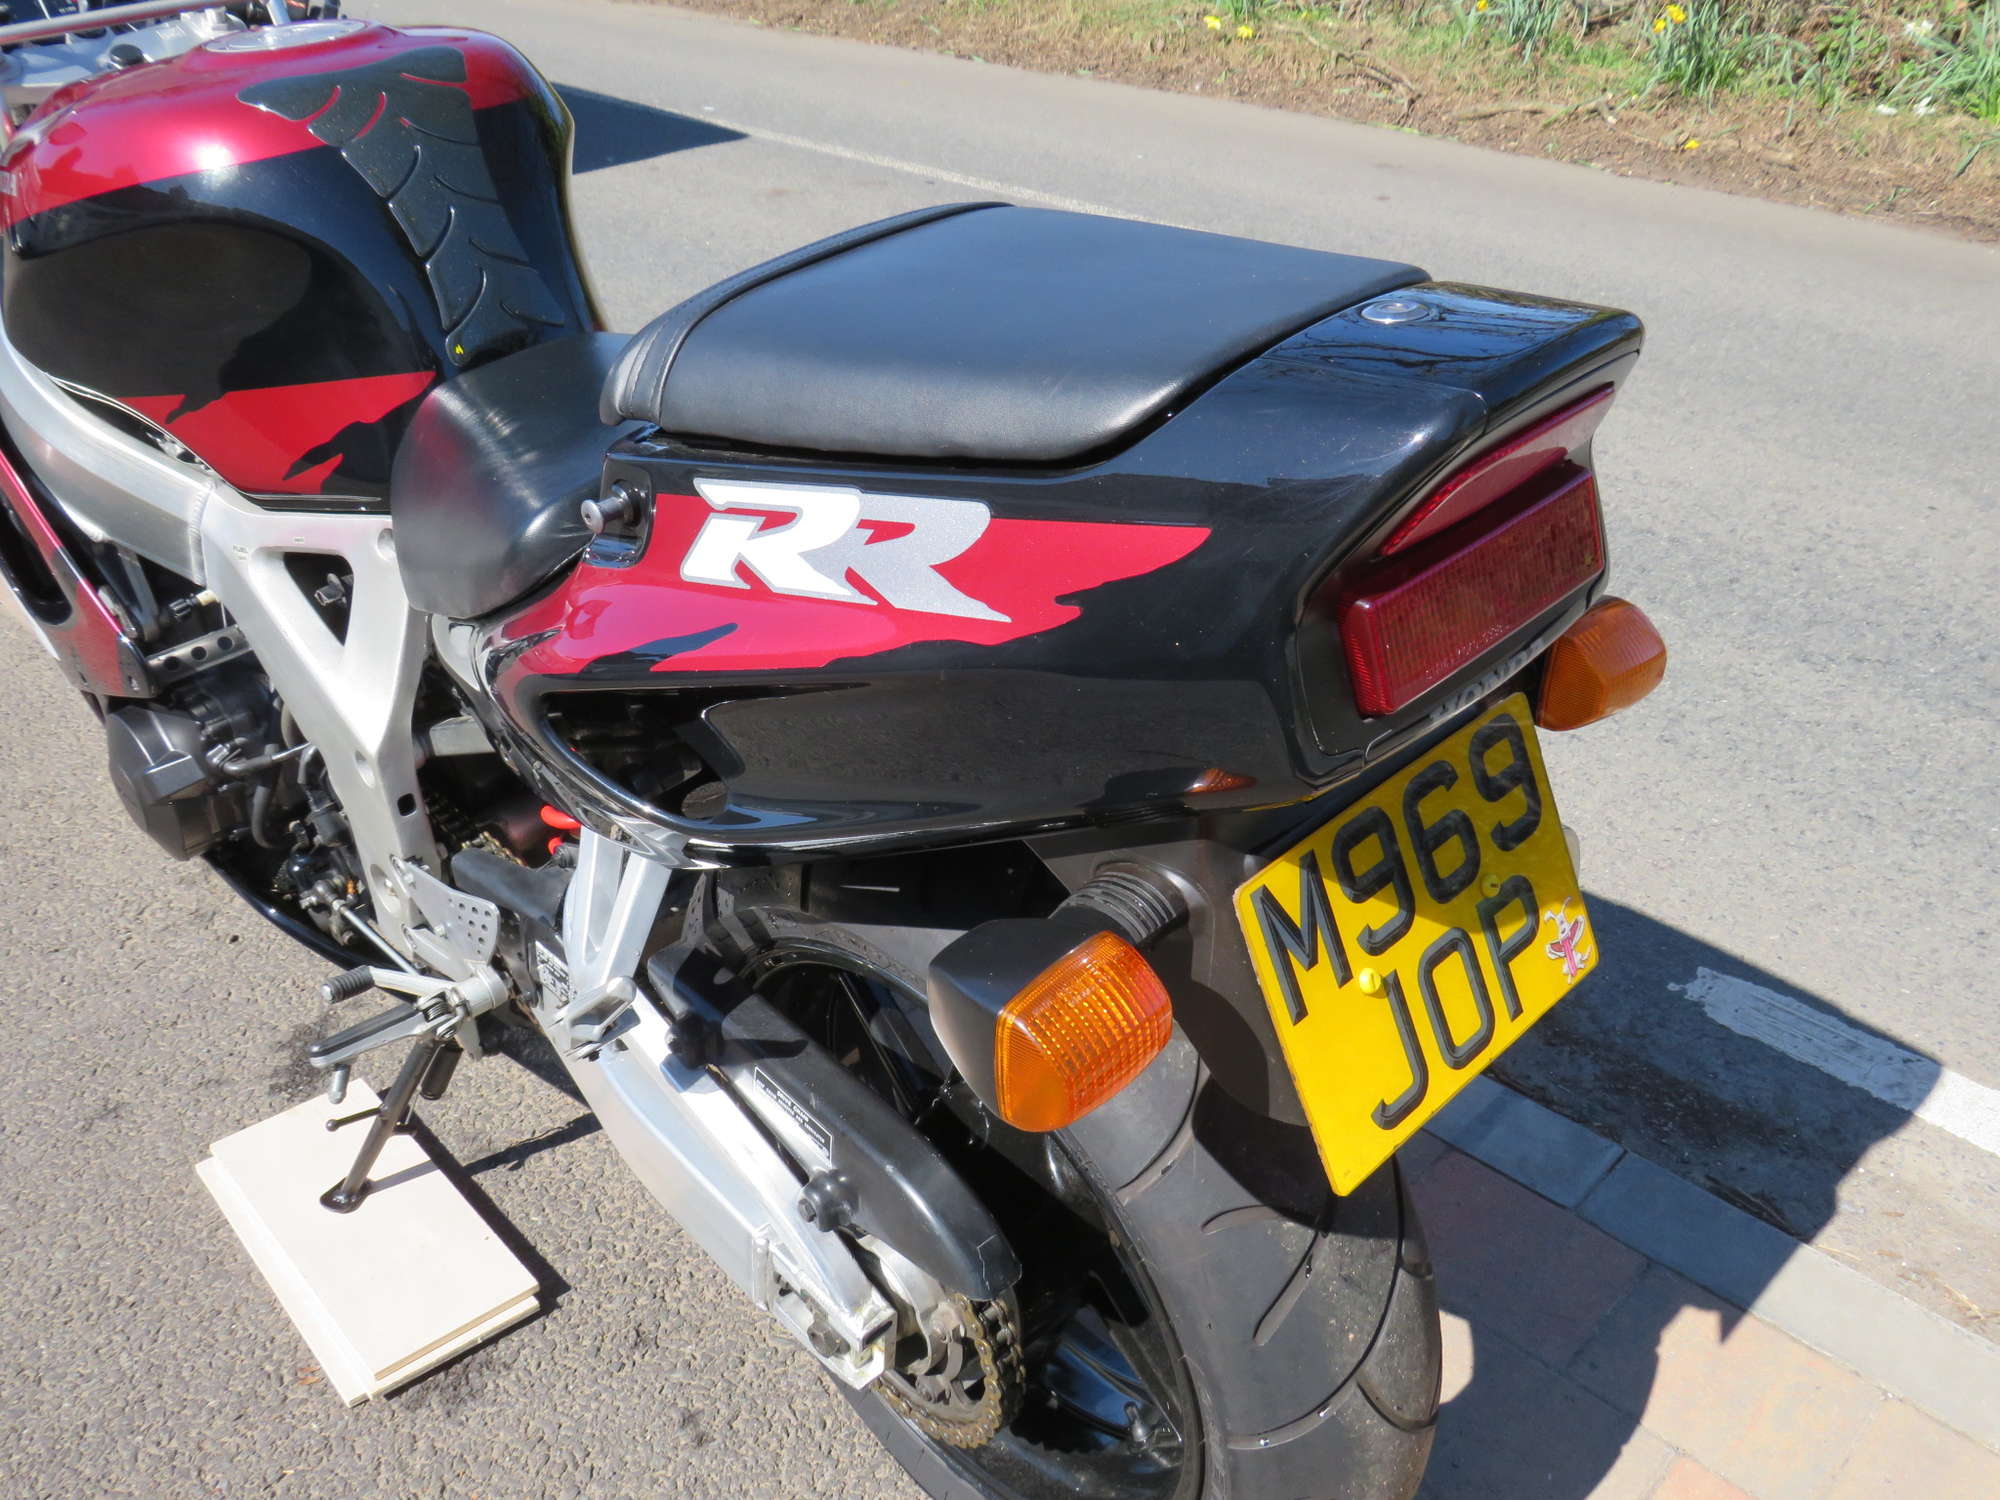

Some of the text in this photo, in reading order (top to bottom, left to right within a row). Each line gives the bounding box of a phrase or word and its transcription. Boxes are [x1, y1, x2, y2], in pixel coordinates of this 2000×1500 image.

[680, 477, 1013, 623] RR
[1249, 712, 1543, 1026] M969
[1371, 874, 1541, 1131] JOP
